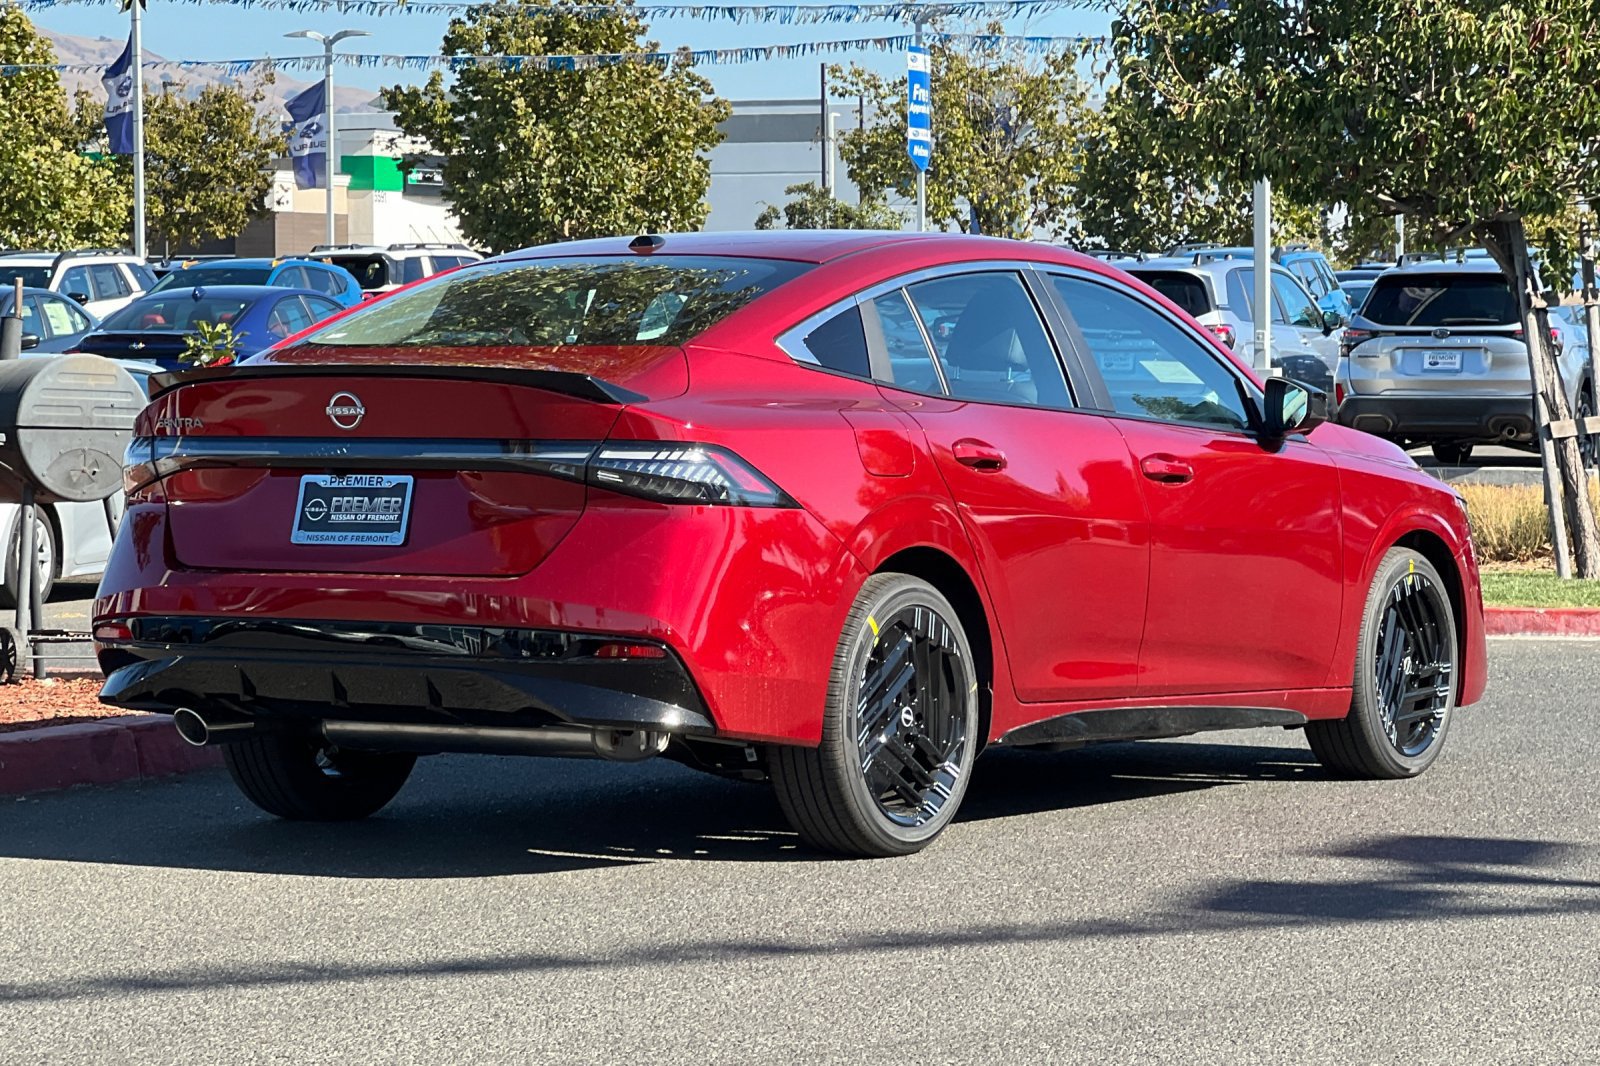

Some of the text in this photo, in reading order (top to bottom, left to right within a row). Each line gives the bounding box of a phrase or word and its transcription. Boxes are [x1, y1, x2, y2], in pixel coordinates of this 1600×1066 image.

[326, 406, 365, 416] NISSAN
[158, 417, 204, 429] SENTRA
[329, 476, 384, 486] PREMIER
[330, 497, 402, 513] PREMIER
[306, 534, 336, 542] NISSAN
[350, 535, 390, 543] FREMONT
